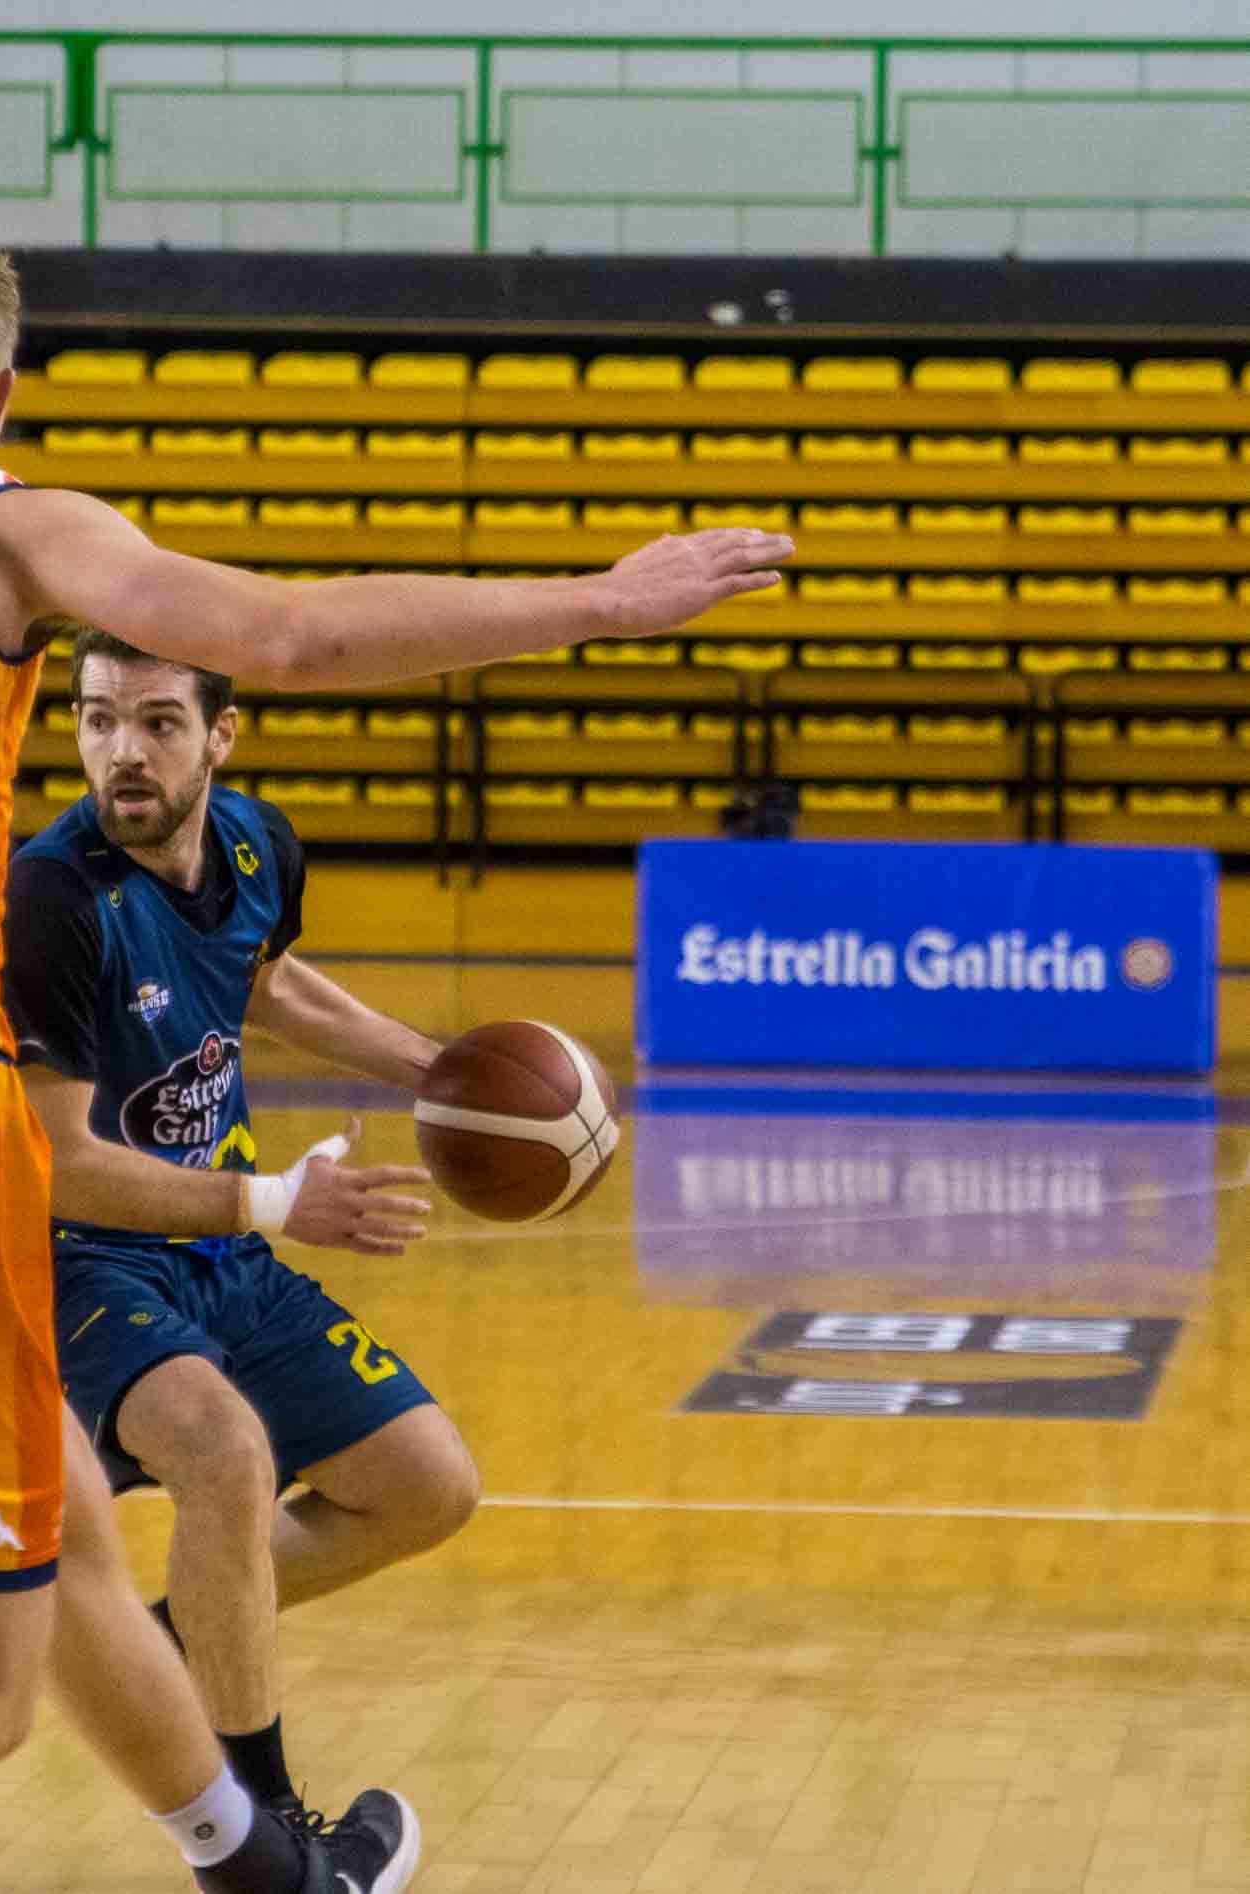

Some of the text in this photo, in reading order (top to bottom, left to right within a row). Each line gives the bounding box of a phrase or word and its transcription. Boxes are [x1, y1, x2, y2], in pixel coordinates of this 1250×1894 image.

[677, 922, 1107, 992] Estrella Galicia
[151, 1059, 240, 1113] Estrell
[325, 1321, 399, 1385] 2
